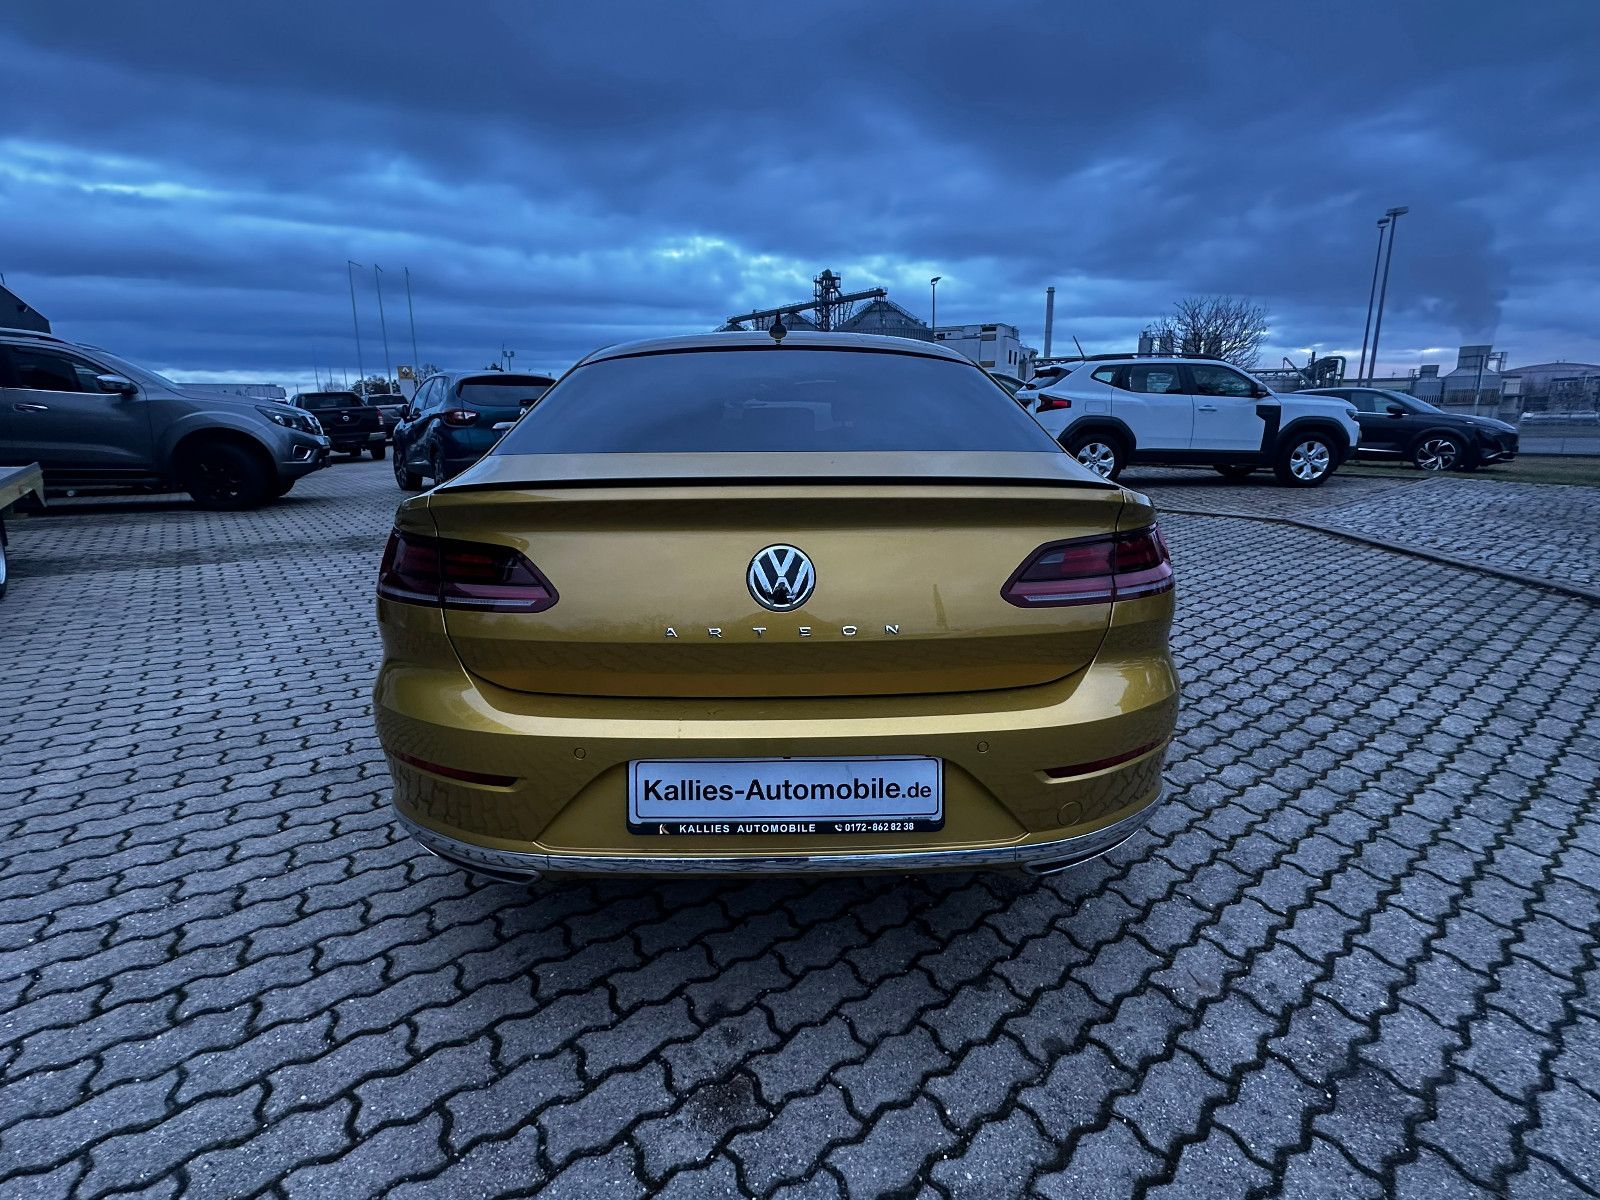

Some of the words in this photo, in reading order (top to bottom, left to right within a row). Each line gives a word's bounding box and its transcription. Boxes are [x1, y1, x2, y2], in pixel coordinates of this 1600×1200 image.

[750, 546, 813, 608] VW
[665, 624, 900, 638] ARTEON
[643, 777, 932, 801] Kallies-Automobile.de
[679, 824, 730, 833] KALLIES
[737, 823, 816, 833] AUTOMOBILE
